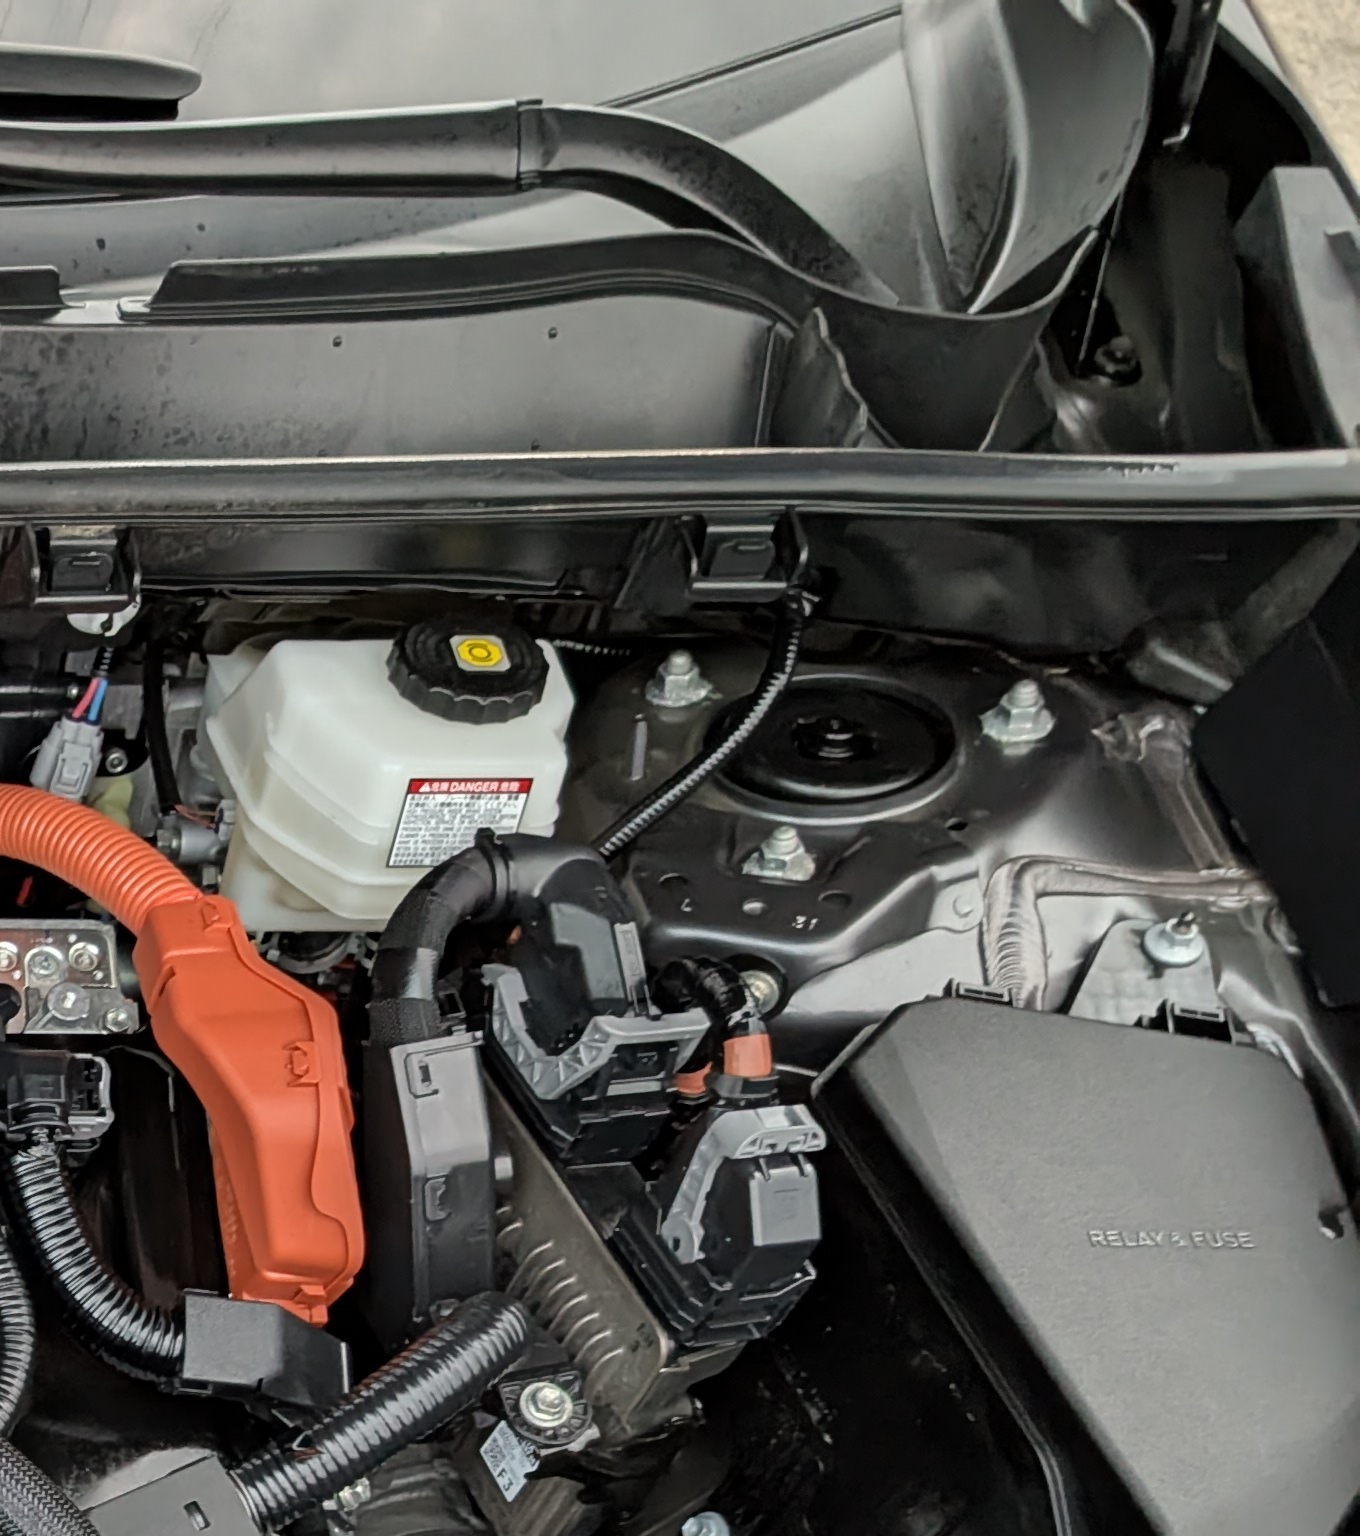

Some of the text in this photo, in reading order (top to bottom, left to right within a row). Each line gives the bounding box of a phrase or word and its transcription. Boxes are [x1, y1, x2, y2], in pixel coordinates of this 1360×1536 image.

[450, 781, 499, 792] DANGER
[1086, 1229, 1166, 1248] RELAY
[1190, 1230, 1256, 1250] FUSE
